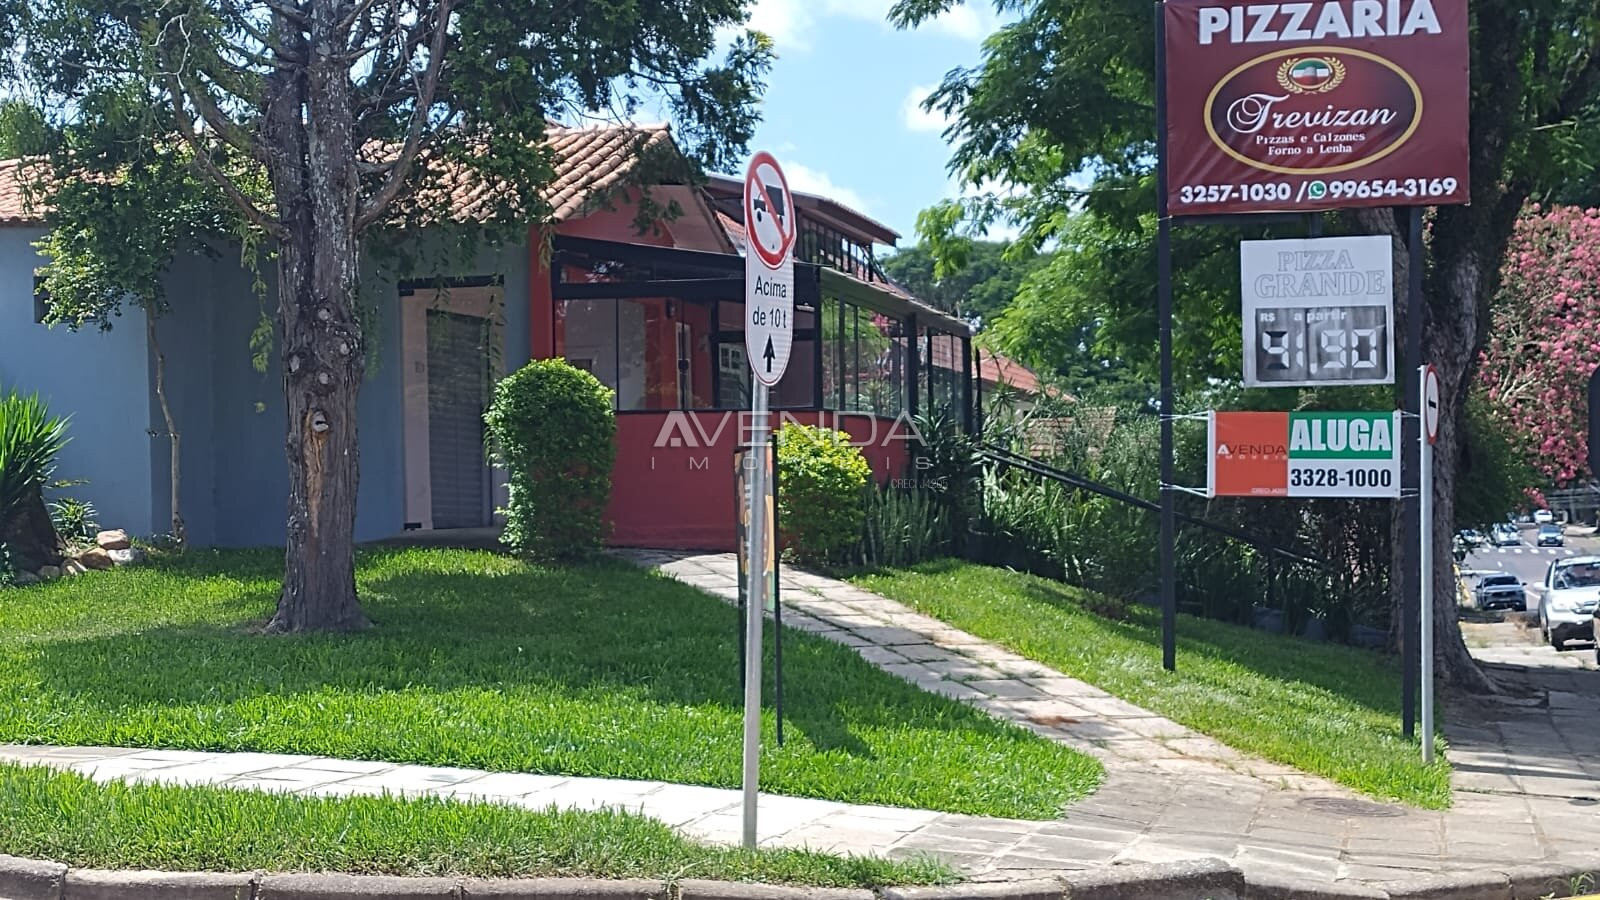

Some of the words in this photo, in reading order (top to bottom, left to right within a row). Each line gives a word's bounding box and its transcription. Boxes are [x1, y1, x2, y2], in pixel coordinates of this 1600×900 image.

[1199, 0, 1442, 45] PIZZARIA
[1227, 93, 1397, 134] Trevizan
[1256, 135, 1294, 145] Pizzas
[1313, 132, 1366, 143] Calzones
[1268, 146, 1301, 156] Forno
[1319, 144, 1353, 154] Lenha
[1180, 183, 1291, 203] 3257-1030
[1329, 177, 1457, 199] 99654-3169
[1277, 249, 1355, 272] PIZZA
[755, 275, 786, 298] Acima
[1254, 270, 1386, 299] GRANDE
[752, 305, 766, 326] de
[769, 308, 781, 328] 10
[783, 309, 787, 329] t
[1294, 312, 1303, 321] a
[1289, 418, 1392, 452] ALUGA
[1216, 443, 1287, 455] AVENDA
[1290, 468, 1392, 487] 3328-1000
